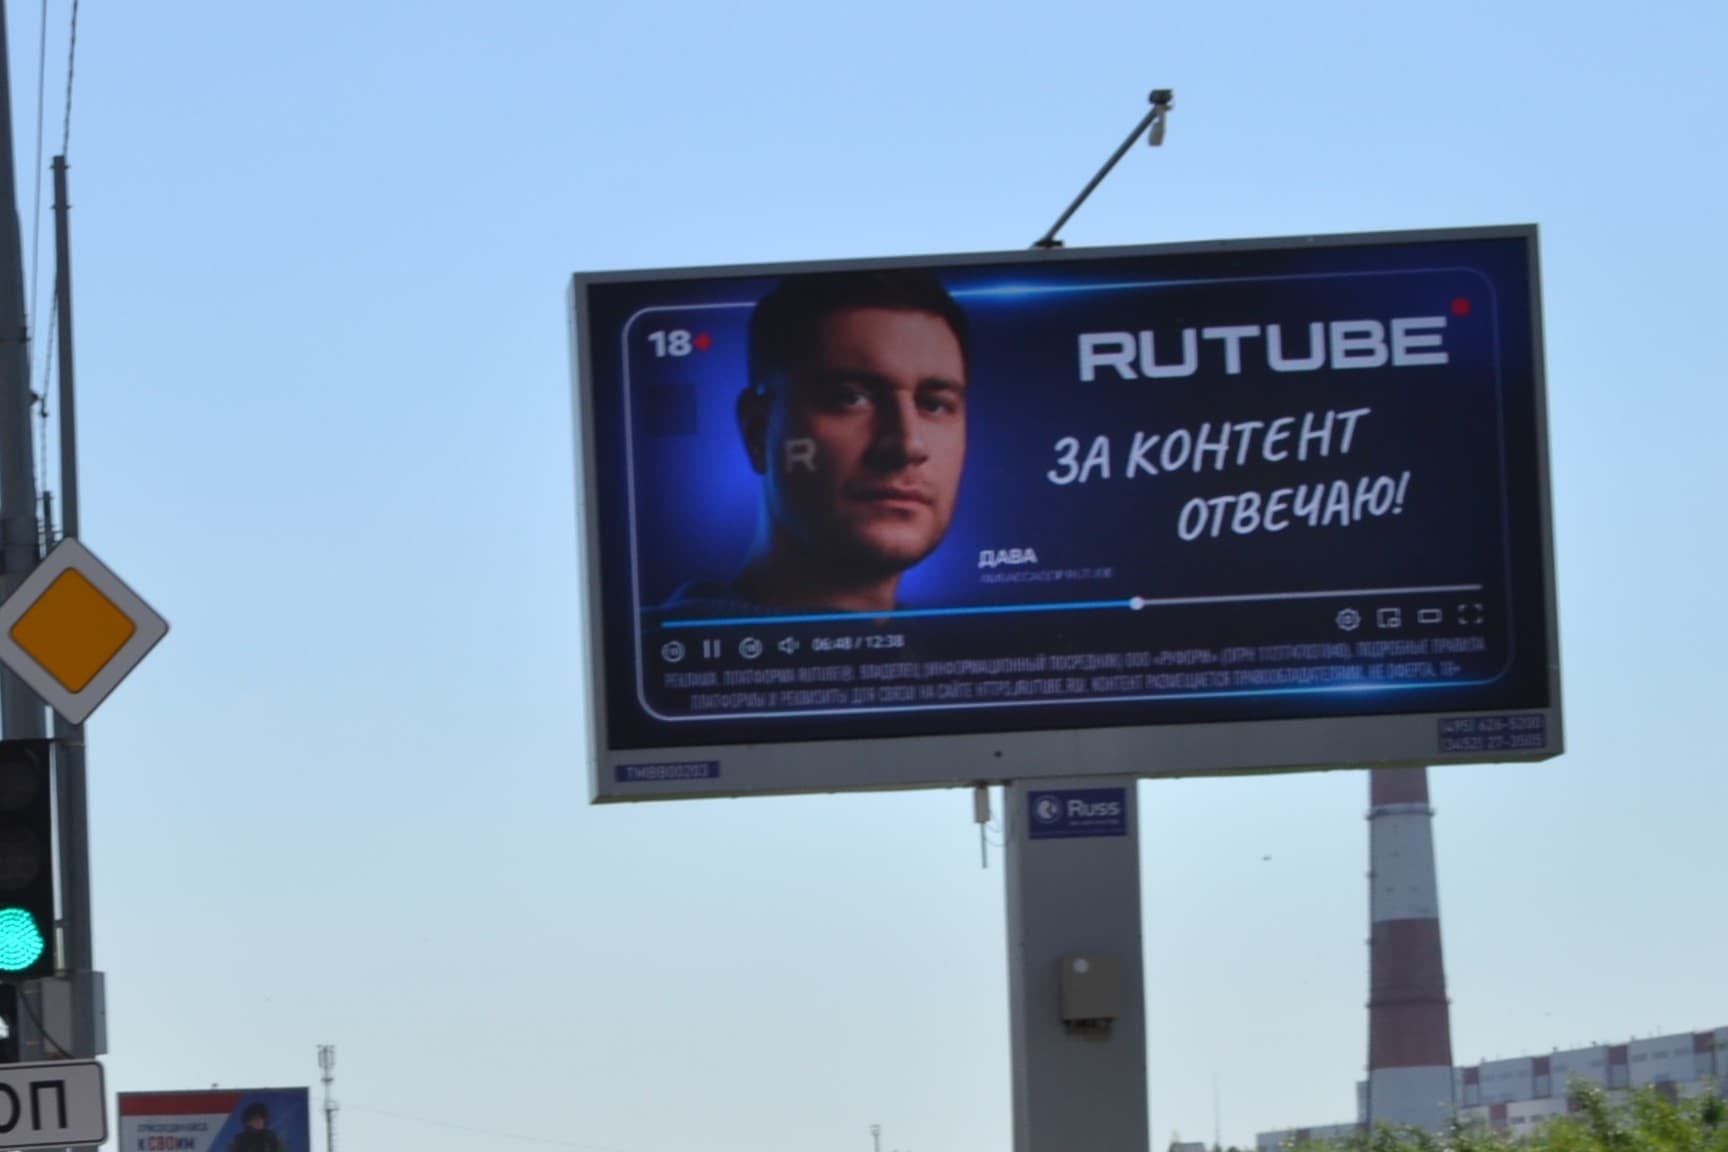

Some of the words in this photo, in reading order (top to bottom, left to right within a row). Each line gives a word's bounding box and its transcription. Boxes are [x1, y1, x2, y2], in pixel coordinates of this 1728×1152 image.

[1078, 316, 1450, 382] RUTUBE
[783, 436, 818, 473] R
[1046, 434, 1111, 485] ЗА
[1125, 407, 1371, 479] КОНТЕНТ
[1177, 470, 1411, 541] ОТВЕЧАЮ!
[977, 547, 1039, 569] ДАВА
[1066, 798, 1121, 817] Russ
